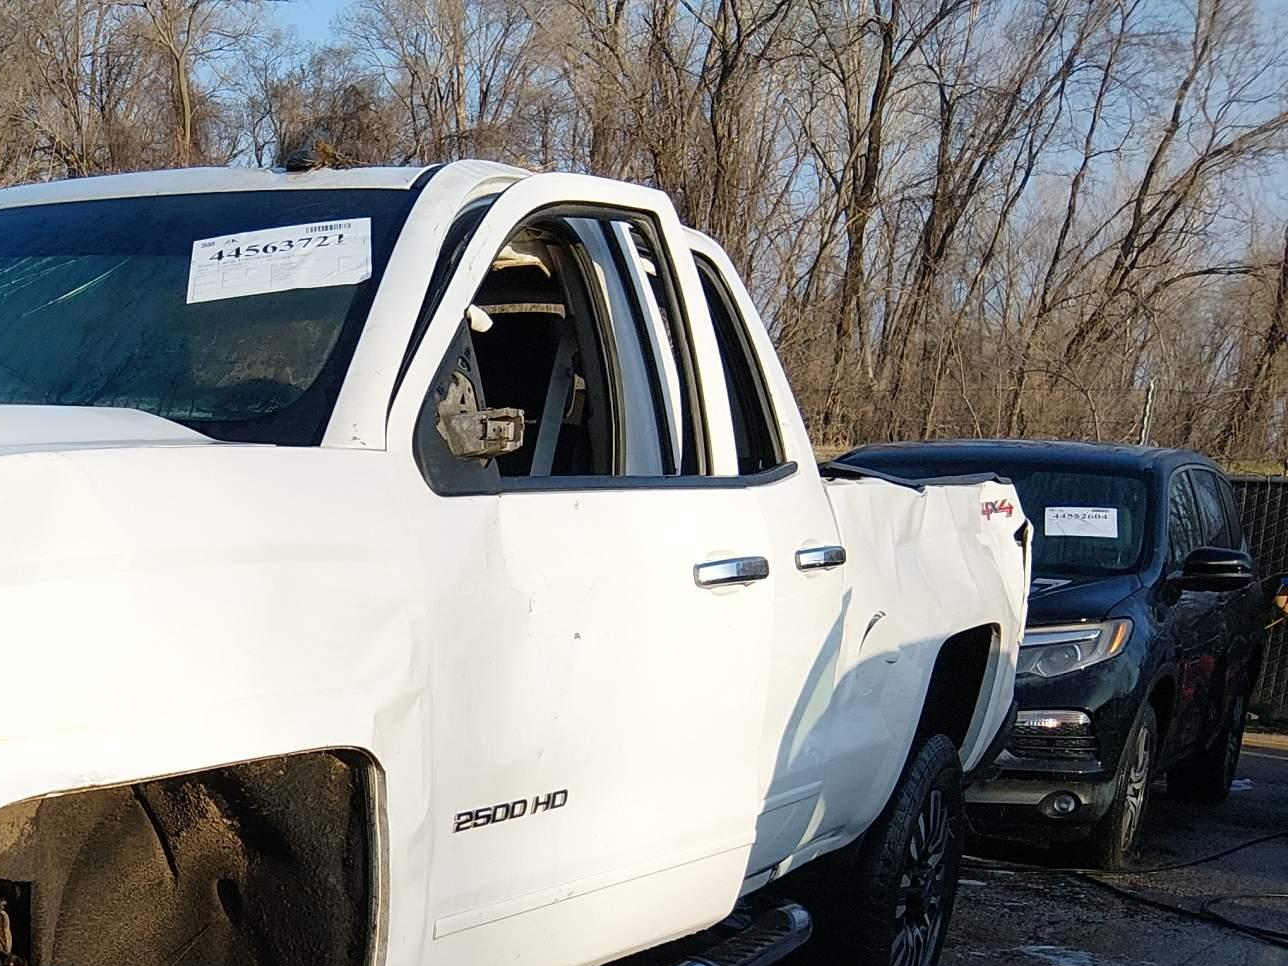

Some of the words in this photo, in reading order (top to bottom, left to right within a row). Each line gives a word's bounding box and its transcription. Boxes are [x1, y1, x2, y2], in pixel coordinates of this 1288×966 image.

[209, 233, 345, 262] 44563721
[453, 798, 528, 833] 2500
[530, 789, 569, 815] HD
